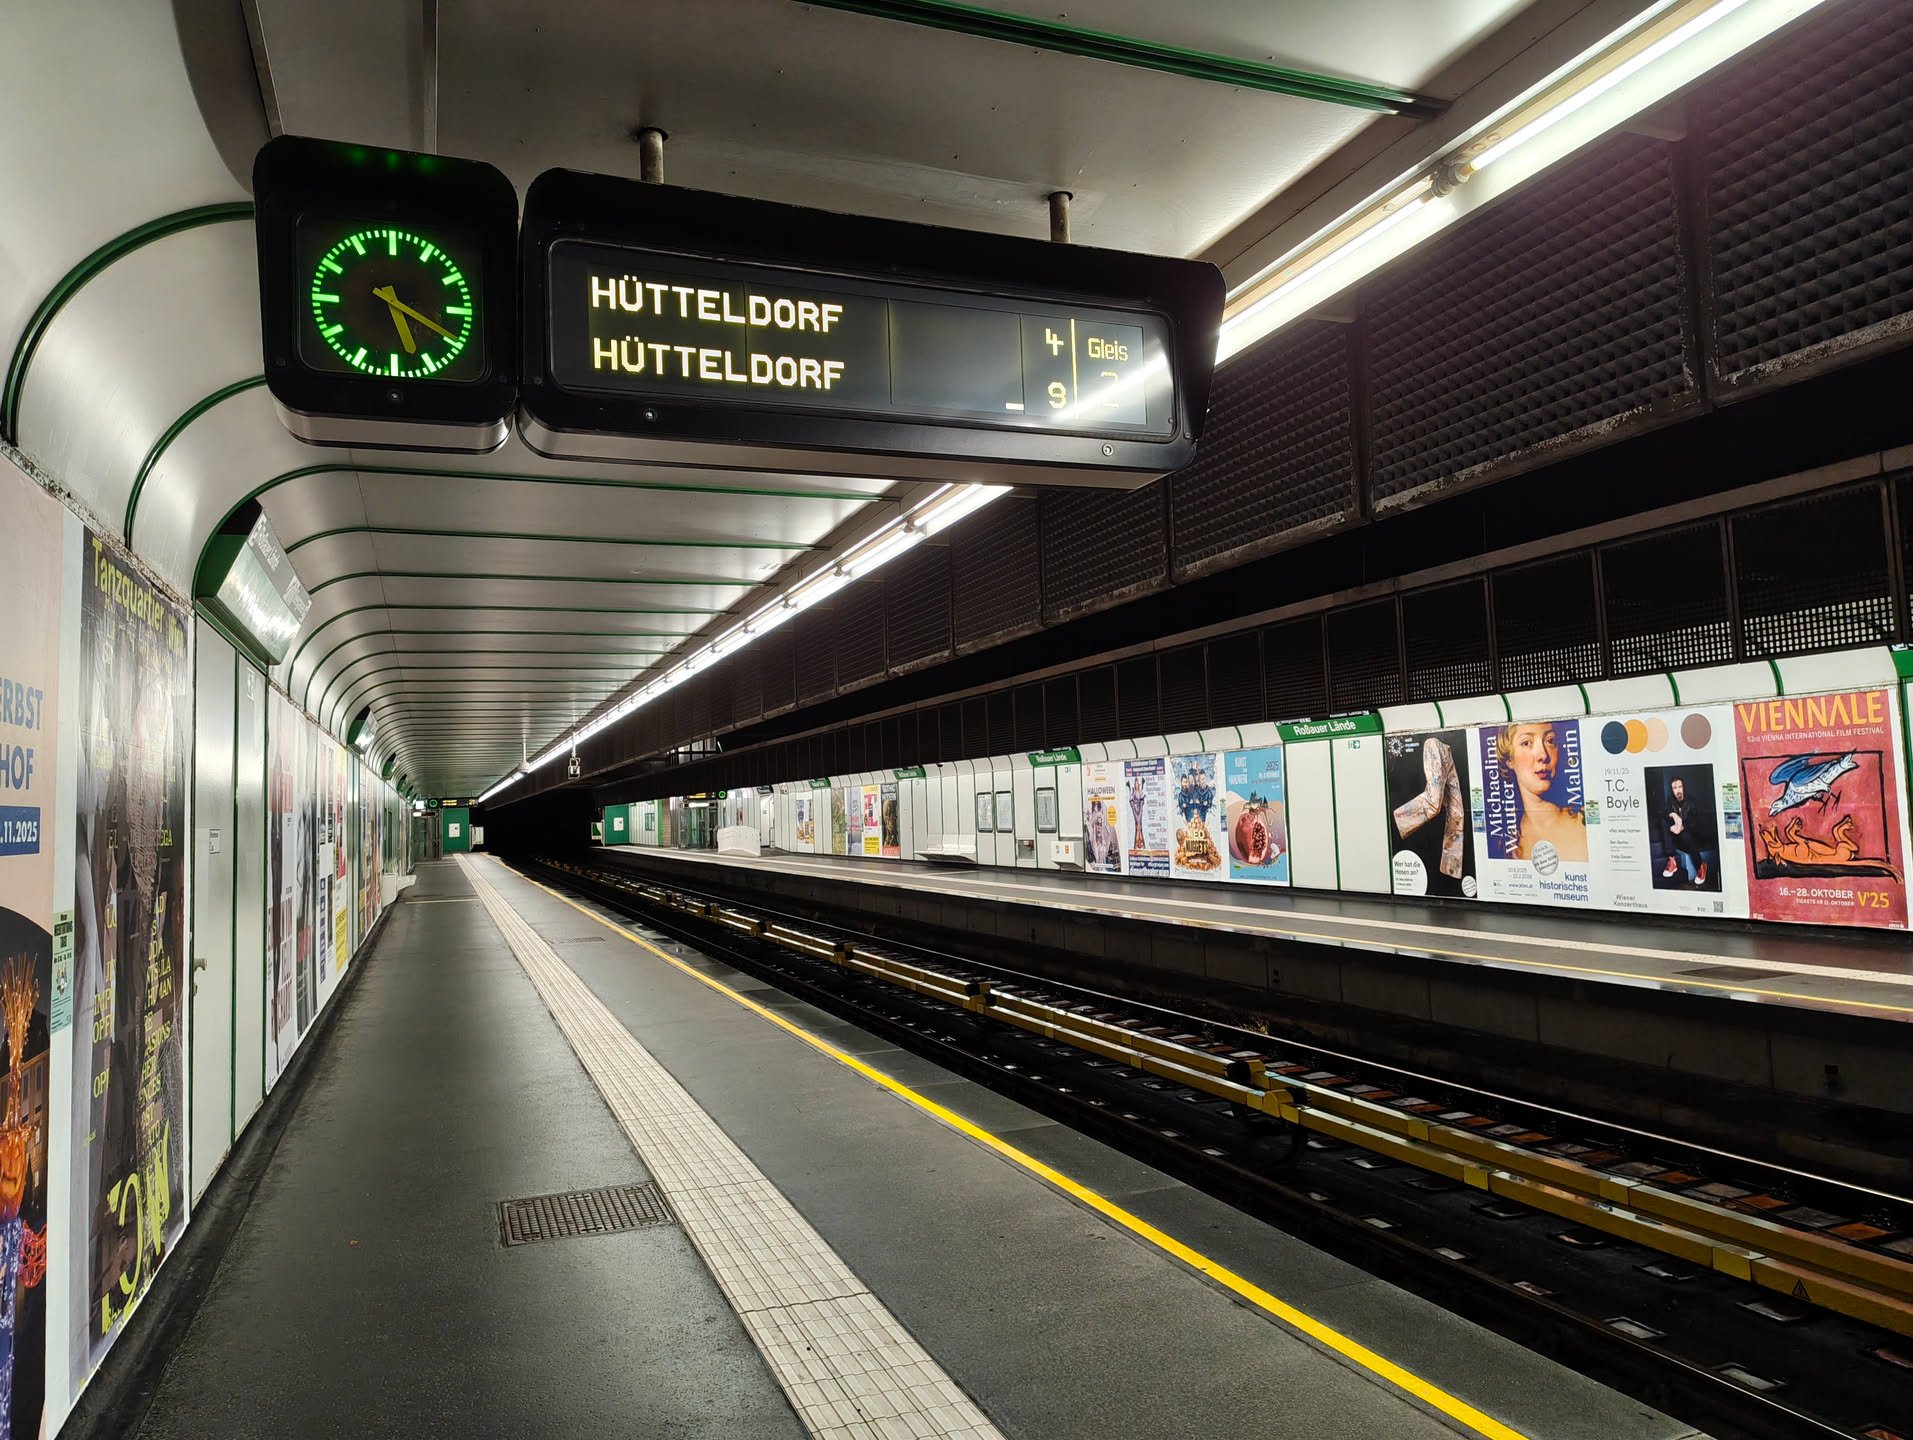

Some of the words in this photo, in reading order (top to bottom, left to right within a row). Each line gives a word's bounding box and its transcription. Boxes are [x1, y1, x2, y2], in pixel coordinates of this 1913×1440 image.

[592, 275, 843, 332] HÜTTELDORF
[1045, 328, 1064, 356] 4
[1088, 337, 1129, 362] Gleis
[593, 335, 845, 390] HÜTTELDORF
[1048, 381, 1067, 409] 9
[92, 537, 165, 633] Tanzquartier
[1738, 692, 1884, 733] VIENNALE
[1293, 724, 1328, 736] Roßauer
[1328, 720, 1357, 732] Lände
[1761, 733, 1784, 742] VIENNA
[1784, 730, 1834, 741] INTERNATIONAL
[1836, 729, 1852, 738] FILM
[1853, 727, 1884, 736] FESTIVAL
[1563, 729, 1583, 806] Malerin
[1088, 786, 1115, 795] HALLOWEEN
[1484, 735, 1503, 837] Michaelina
[1605, 779, 1629, 792] T.C.
[1606, 795, 1640, 811] Boyle
[1502, 781, 1519, 854] Wautier
[1564, 872, 1588, 882] kunst
[1539, 880, 1588, 892] historisches
[1811, 889, 1854, 899] OKTOBER
[1553, 892, 1588, 902] museum
[1613, 901, 1648, 909] Konzerthaus
[1857, 891, 1890, 908] V'25
